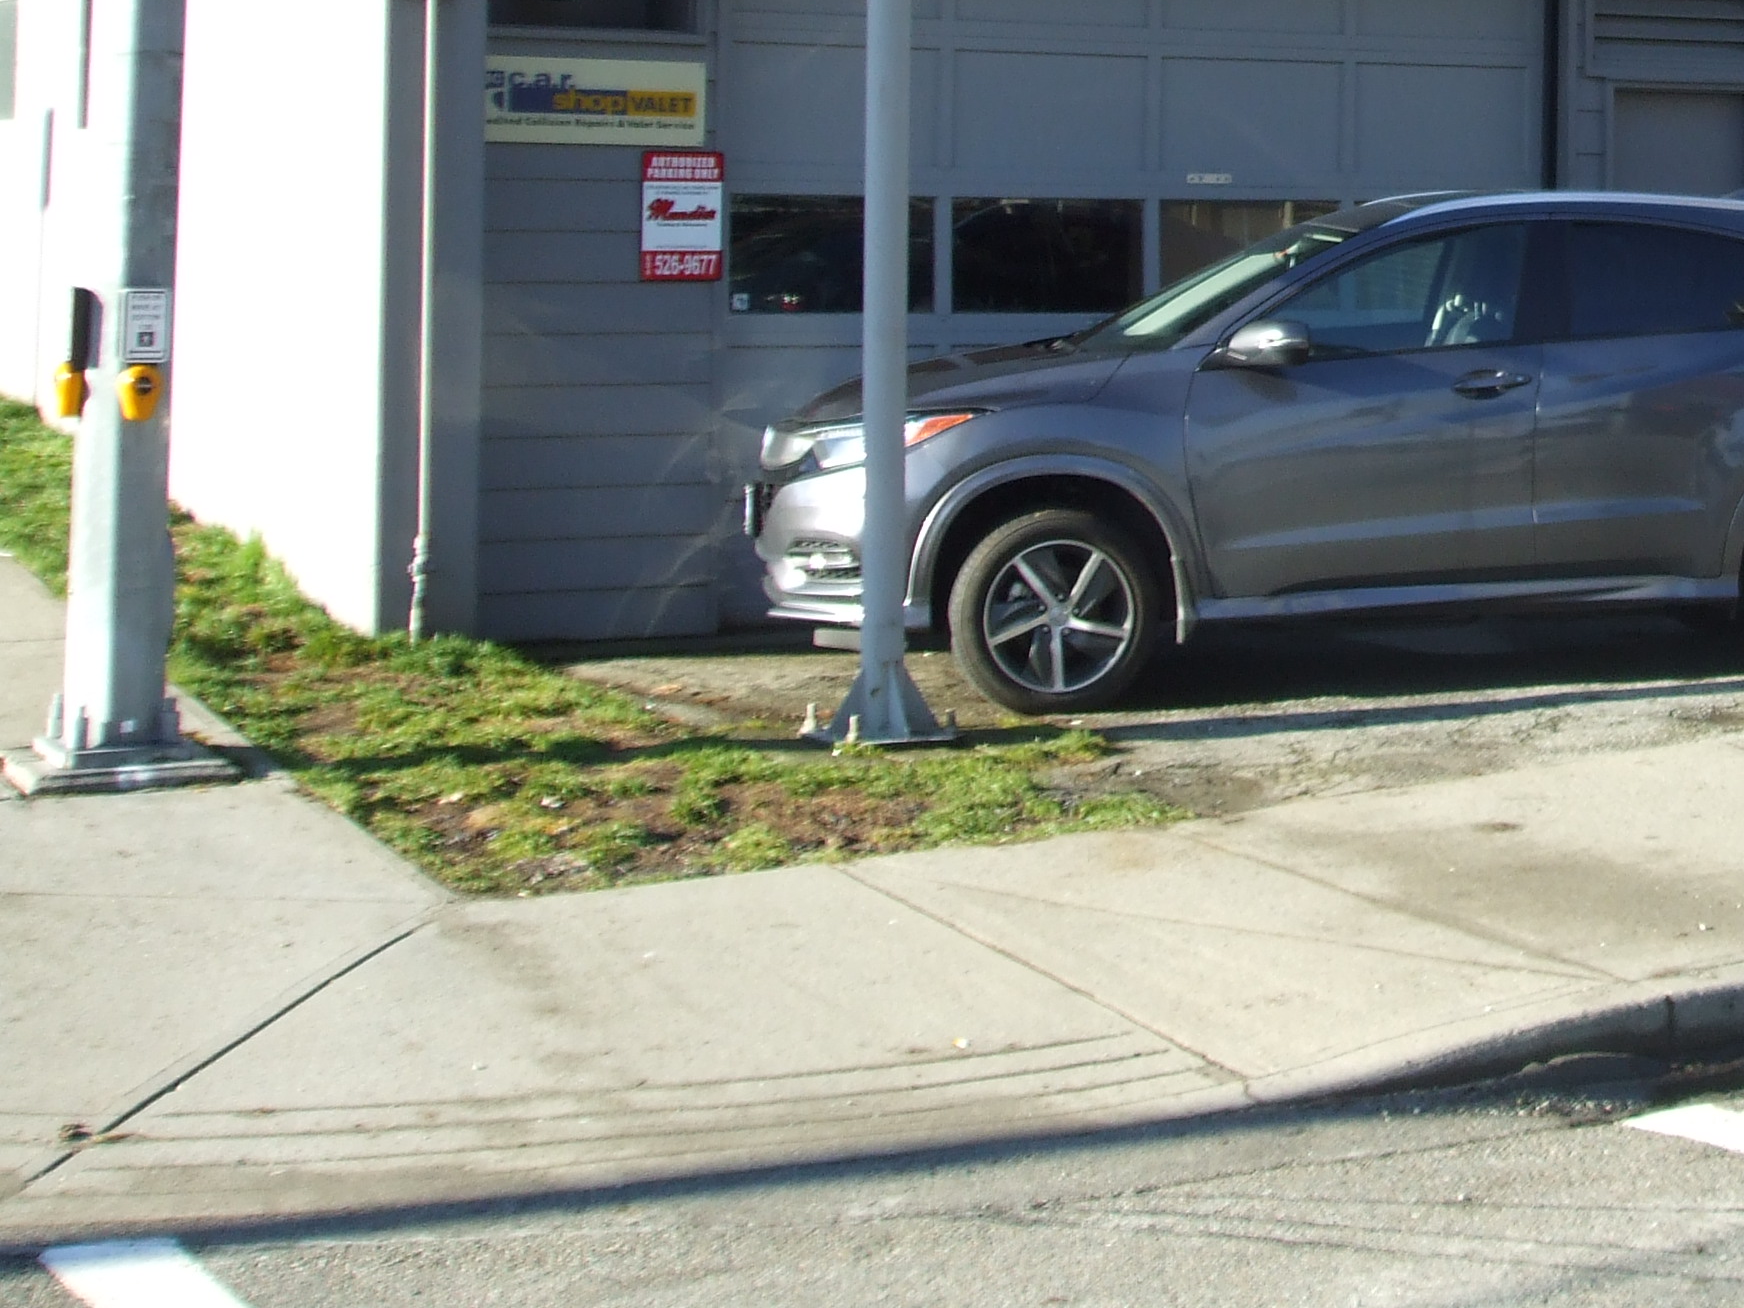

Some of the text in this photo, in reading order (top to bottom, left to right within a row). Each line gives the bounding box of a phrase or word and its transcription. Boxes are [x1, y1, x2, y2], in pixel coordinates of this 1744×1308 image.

[552, 87, 693, 115] shop VALET
[651, 156, 716, 168] AUTHORIZED
[646, 167, 720, 180] PARKING ONLY
[655, 254, 717, 276] 526-9677
